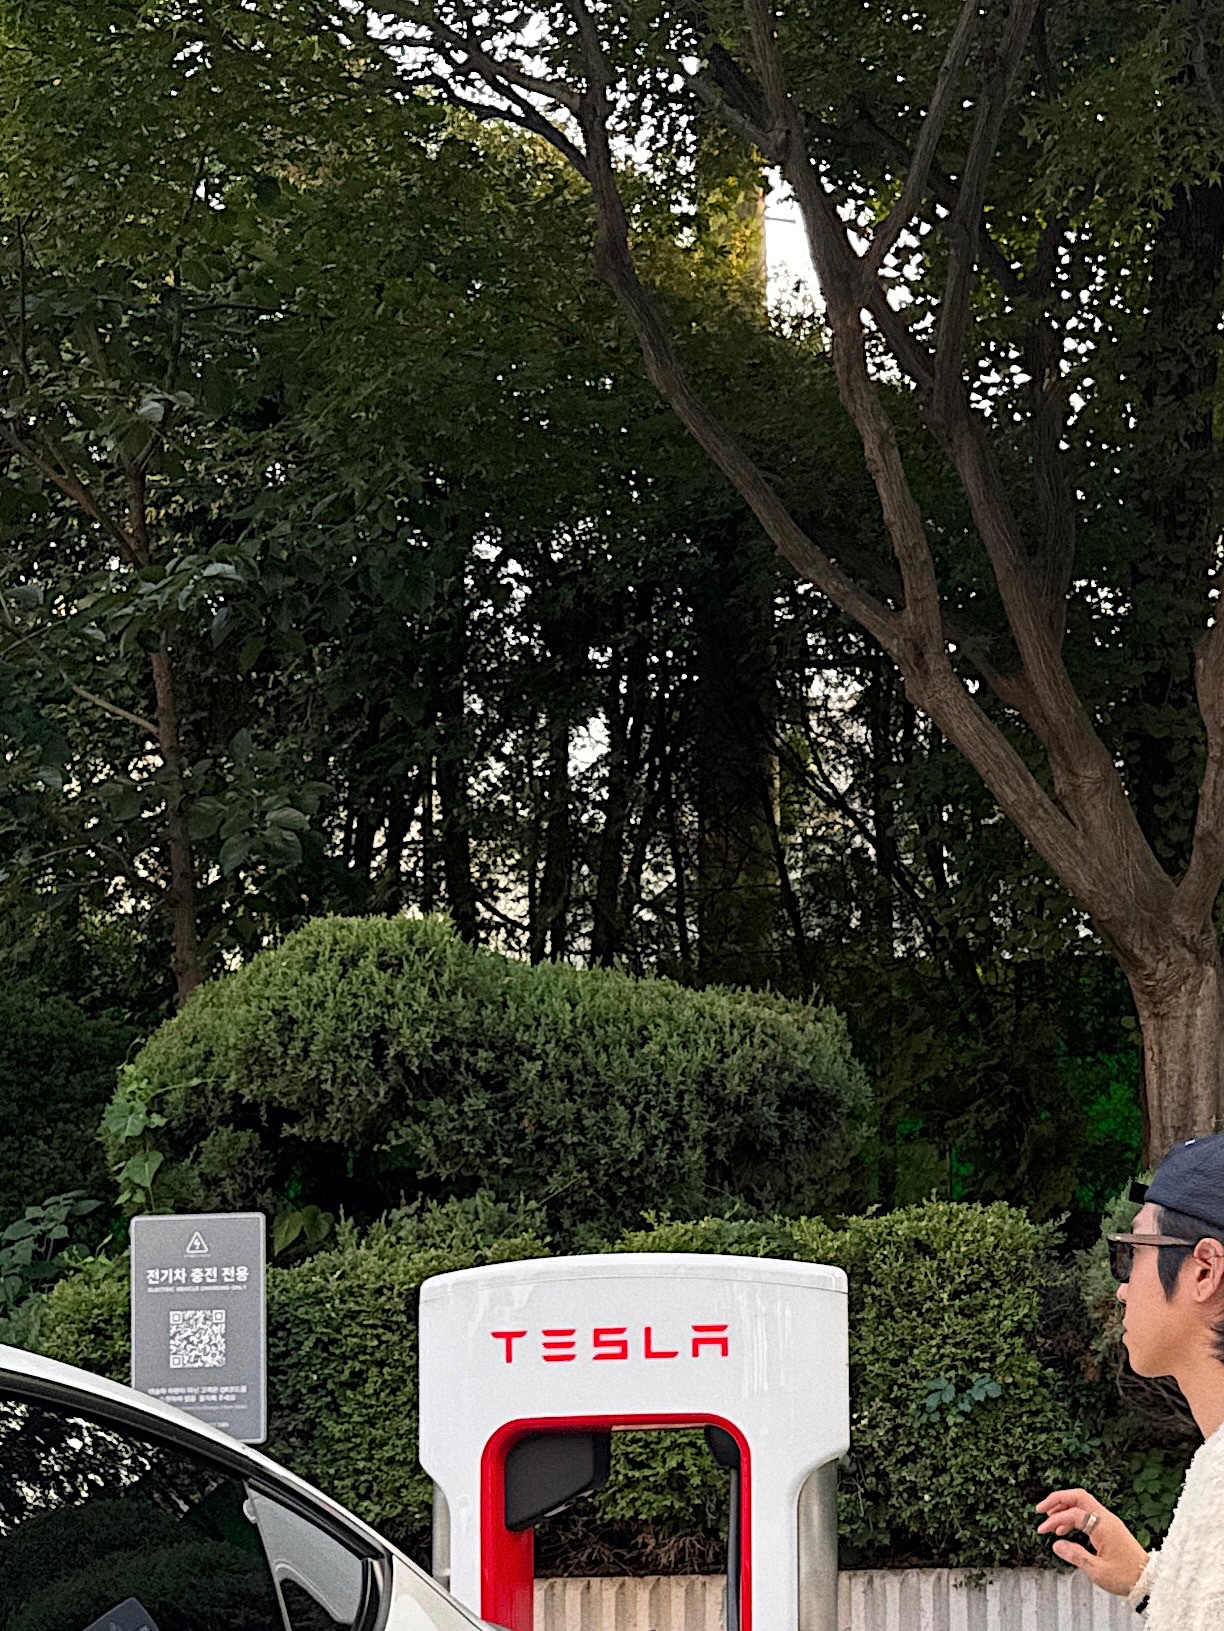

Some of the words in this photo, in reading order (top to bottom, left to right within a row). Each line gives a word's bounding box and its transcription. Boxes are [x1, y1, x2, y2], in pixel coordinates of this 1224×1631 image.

[146, 1268, 187, 1285] 전기차
[190, 1267, 218, 1283] 충전
[221, 1266, 249, 1282] 전용
[490, 1323, 729, 1364] TESLA
